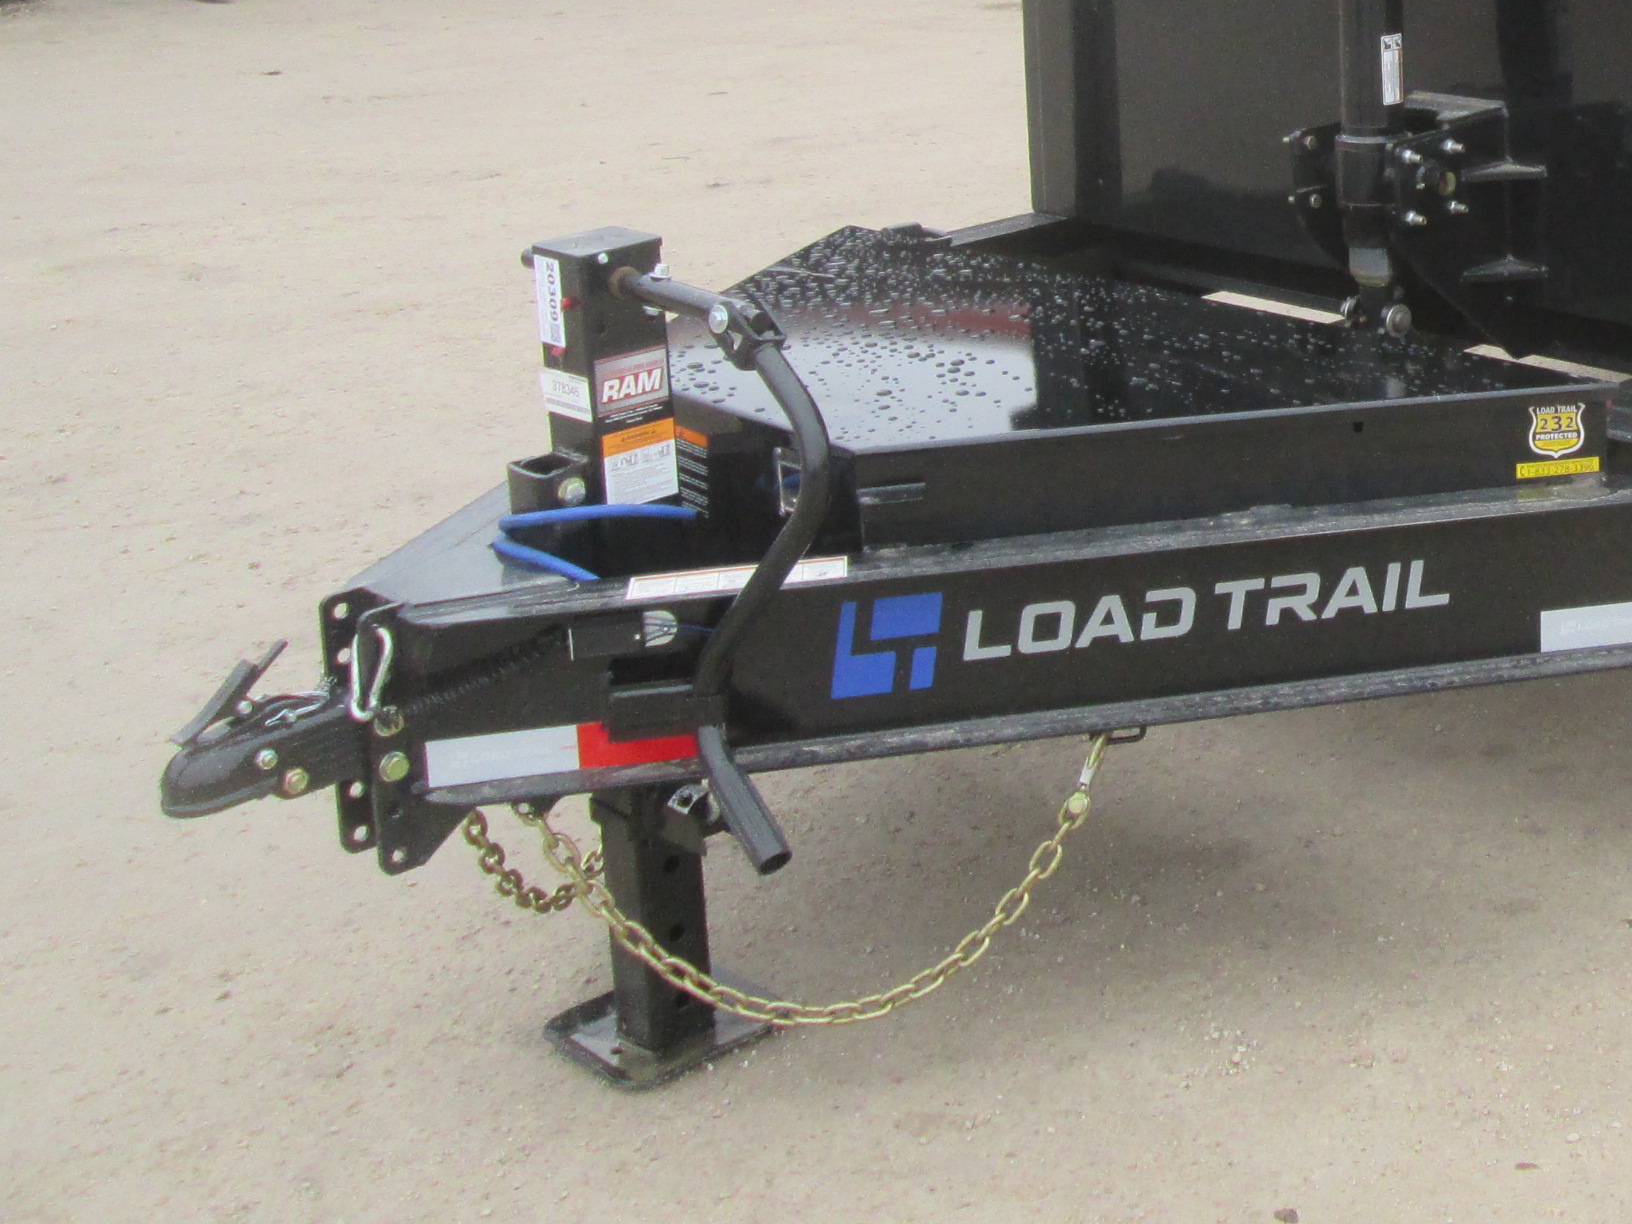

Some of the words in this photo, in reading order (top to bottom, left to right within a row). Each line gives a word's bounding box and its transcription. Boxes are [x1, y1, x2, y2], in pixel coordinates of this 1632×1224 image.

[601, 368, 662, 403] RAM
[1536, 406, 1556, 415] LOAD
[1556, 404, 1578, 414] TRAIL
[1535, 432, 1578, 441] PROTECTED
[963, 586, 1196, 662] LOAD
[1214, 560, 1451, 631] TRAIL
